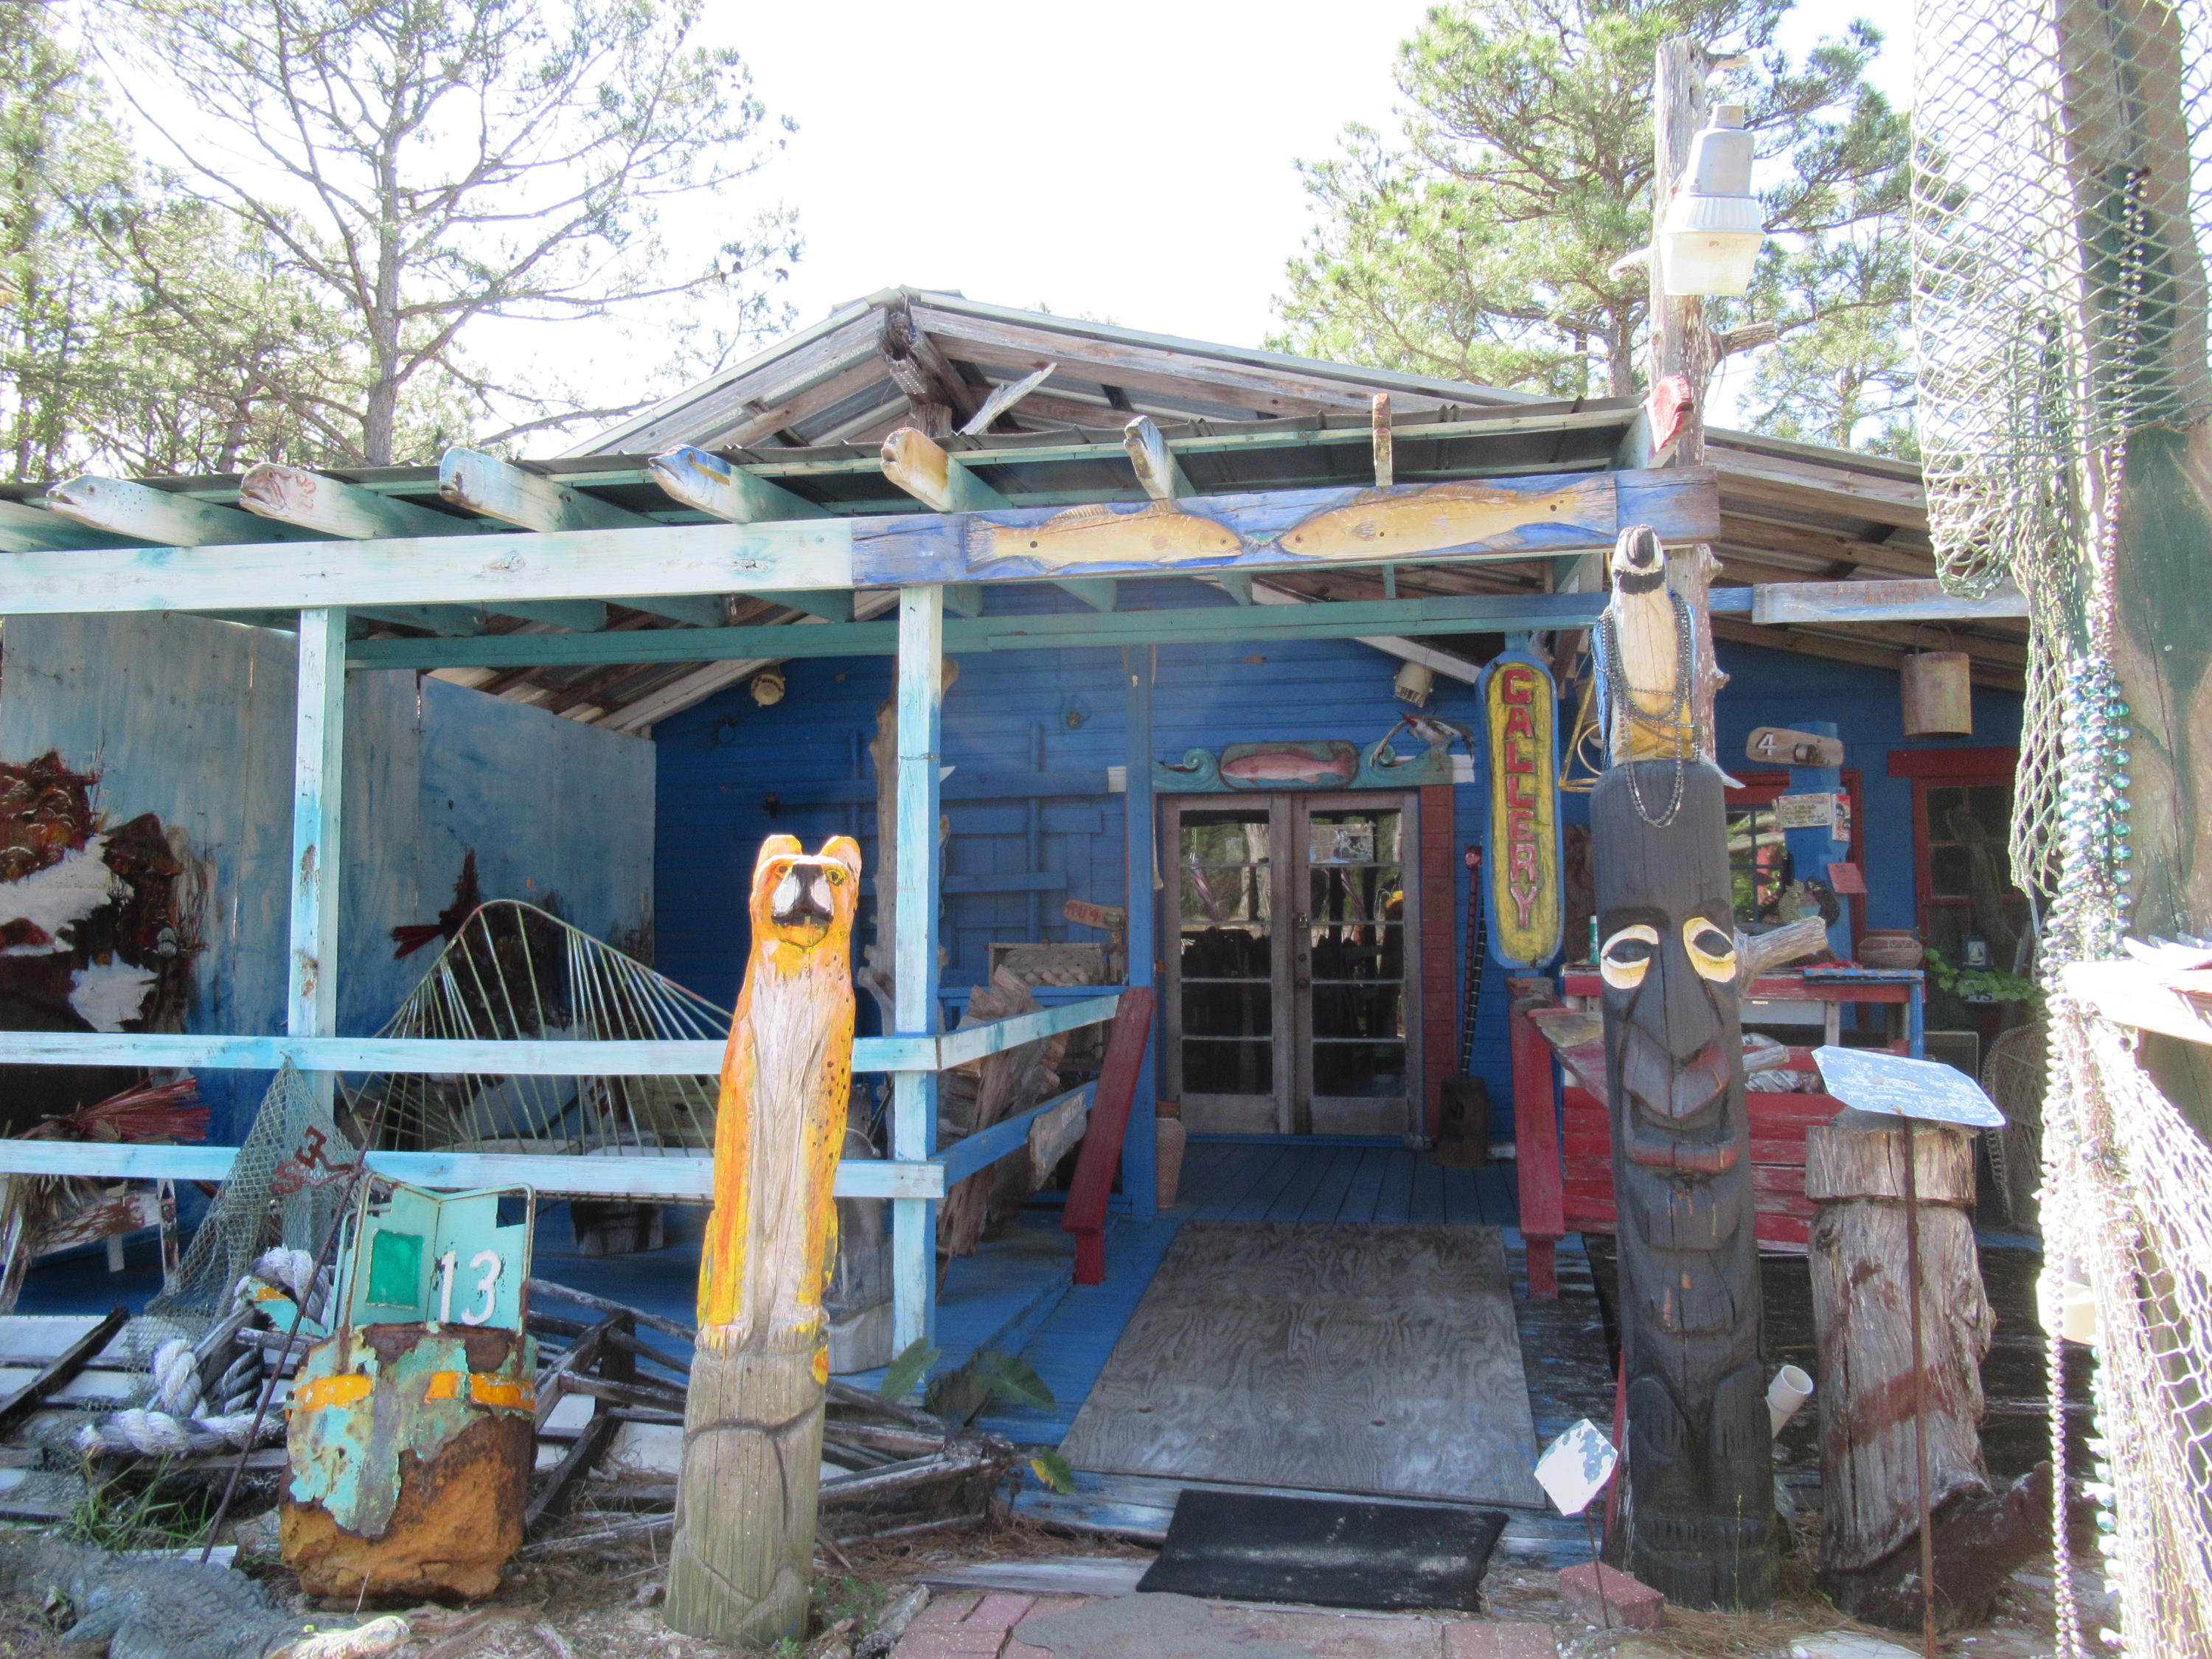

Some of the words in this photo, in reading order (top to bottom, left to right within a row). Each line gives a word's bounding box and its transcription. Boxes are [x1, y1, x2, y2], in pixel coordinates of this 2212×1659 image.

[1756, 731, 1776, 756] 4
[1503, 669, 1540, 928] GALLERY
[440, 1249, 502, 1326] 13
